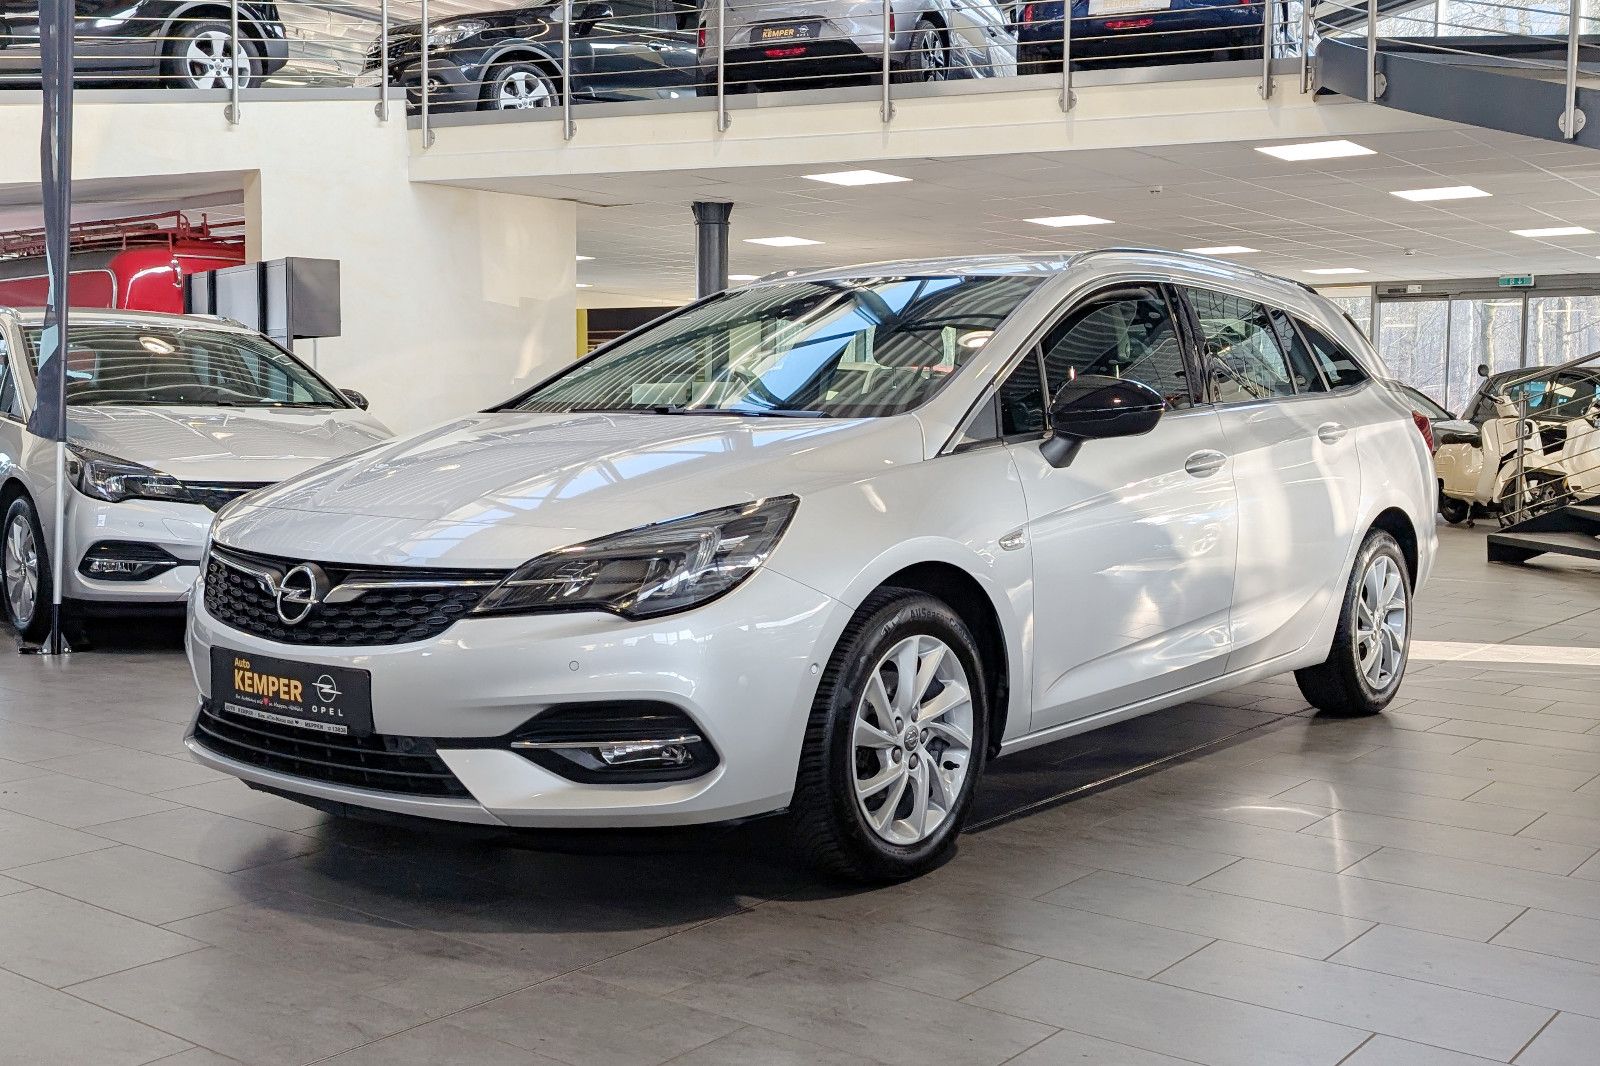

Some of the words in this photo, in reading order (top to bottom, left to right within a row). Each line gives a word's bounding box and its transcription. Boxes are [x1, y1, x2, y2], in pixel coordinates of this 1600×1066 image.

[762, 28, 795, 38] KEMPER
[234, 657, 251, 669] Auto
[234, 668, 303, 703] KEMPER
[311, 705, 343, 717] OPEL
